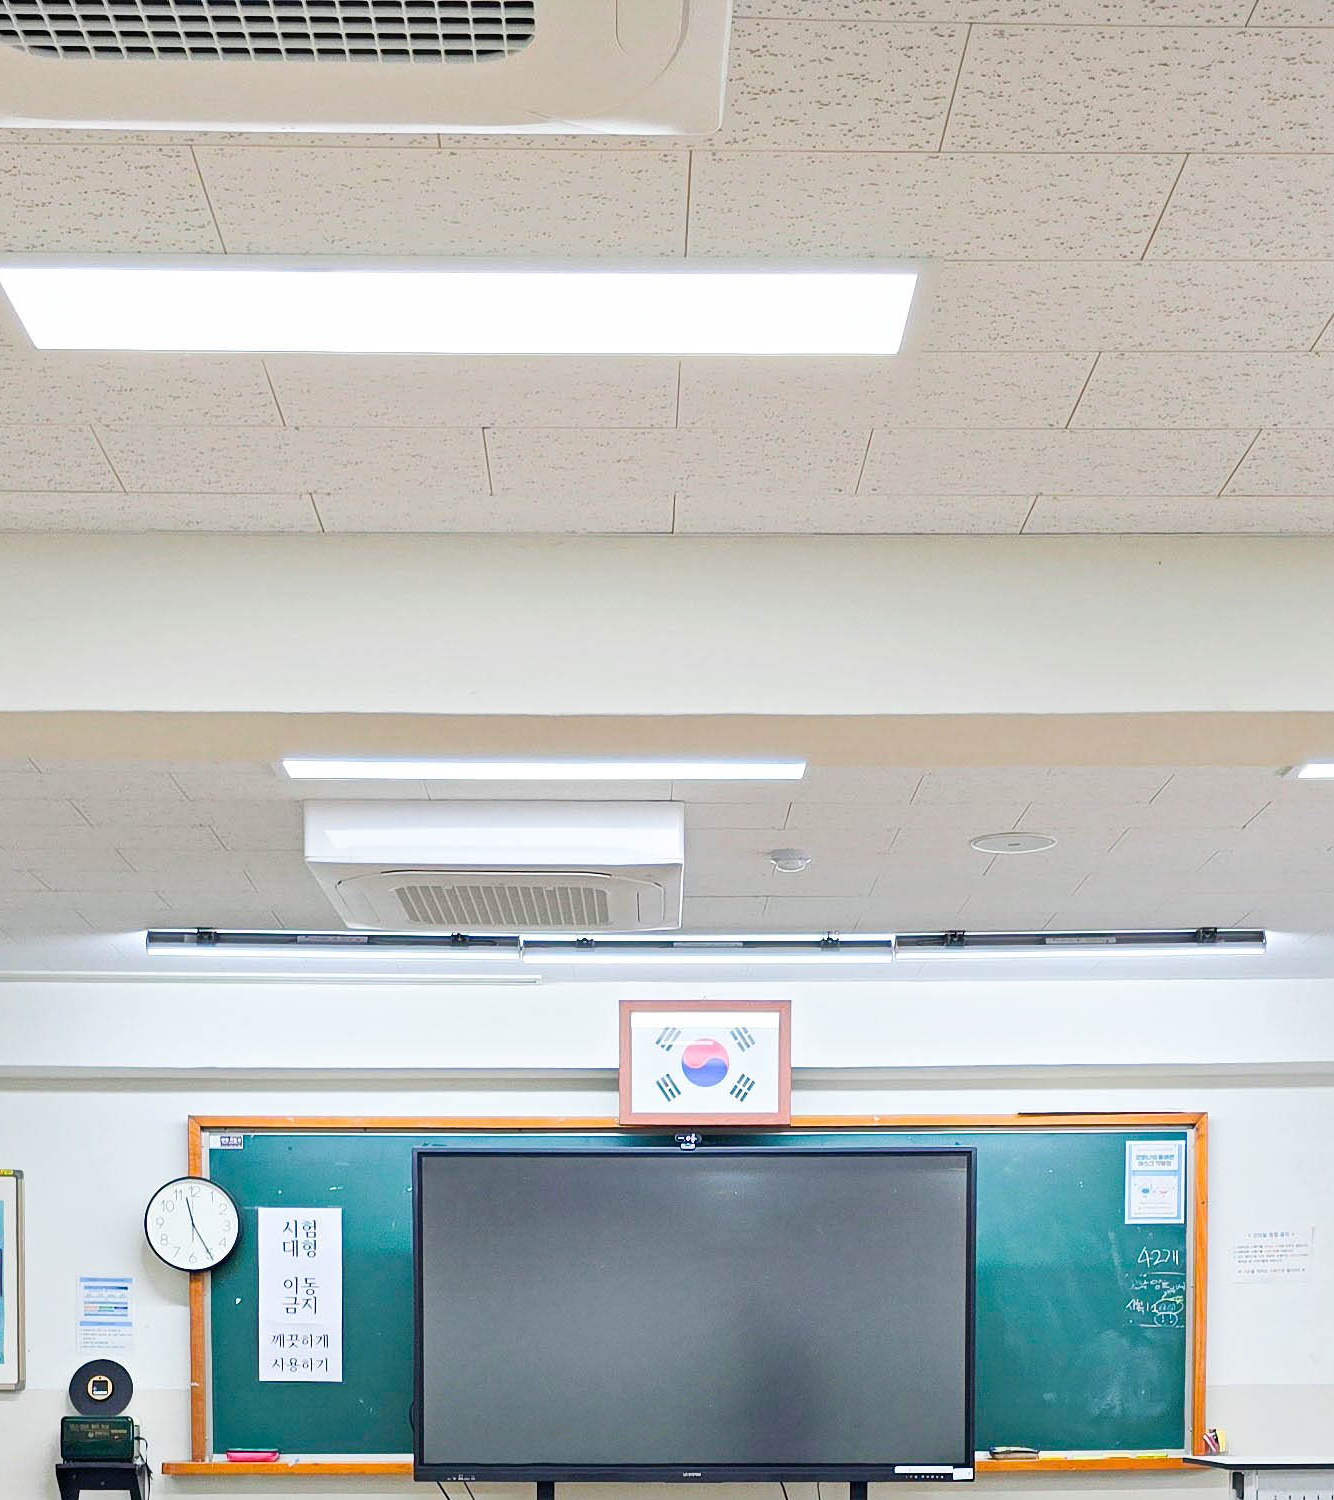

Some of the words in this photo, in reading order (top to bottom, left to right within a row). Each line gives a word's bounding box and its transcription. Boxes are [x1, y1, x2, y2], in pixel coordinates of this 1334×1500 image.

[282, 1220, 317, 1239] 시험
[282, 1240, 317, 1258] 대형
[283, 1277, 319, 1296] 이동
[282, 1297, 317, 1315] 금지
[271, 1334, 330, 1349] 깨끗하게
[271, 1357, 329, 1372] 사용하기
